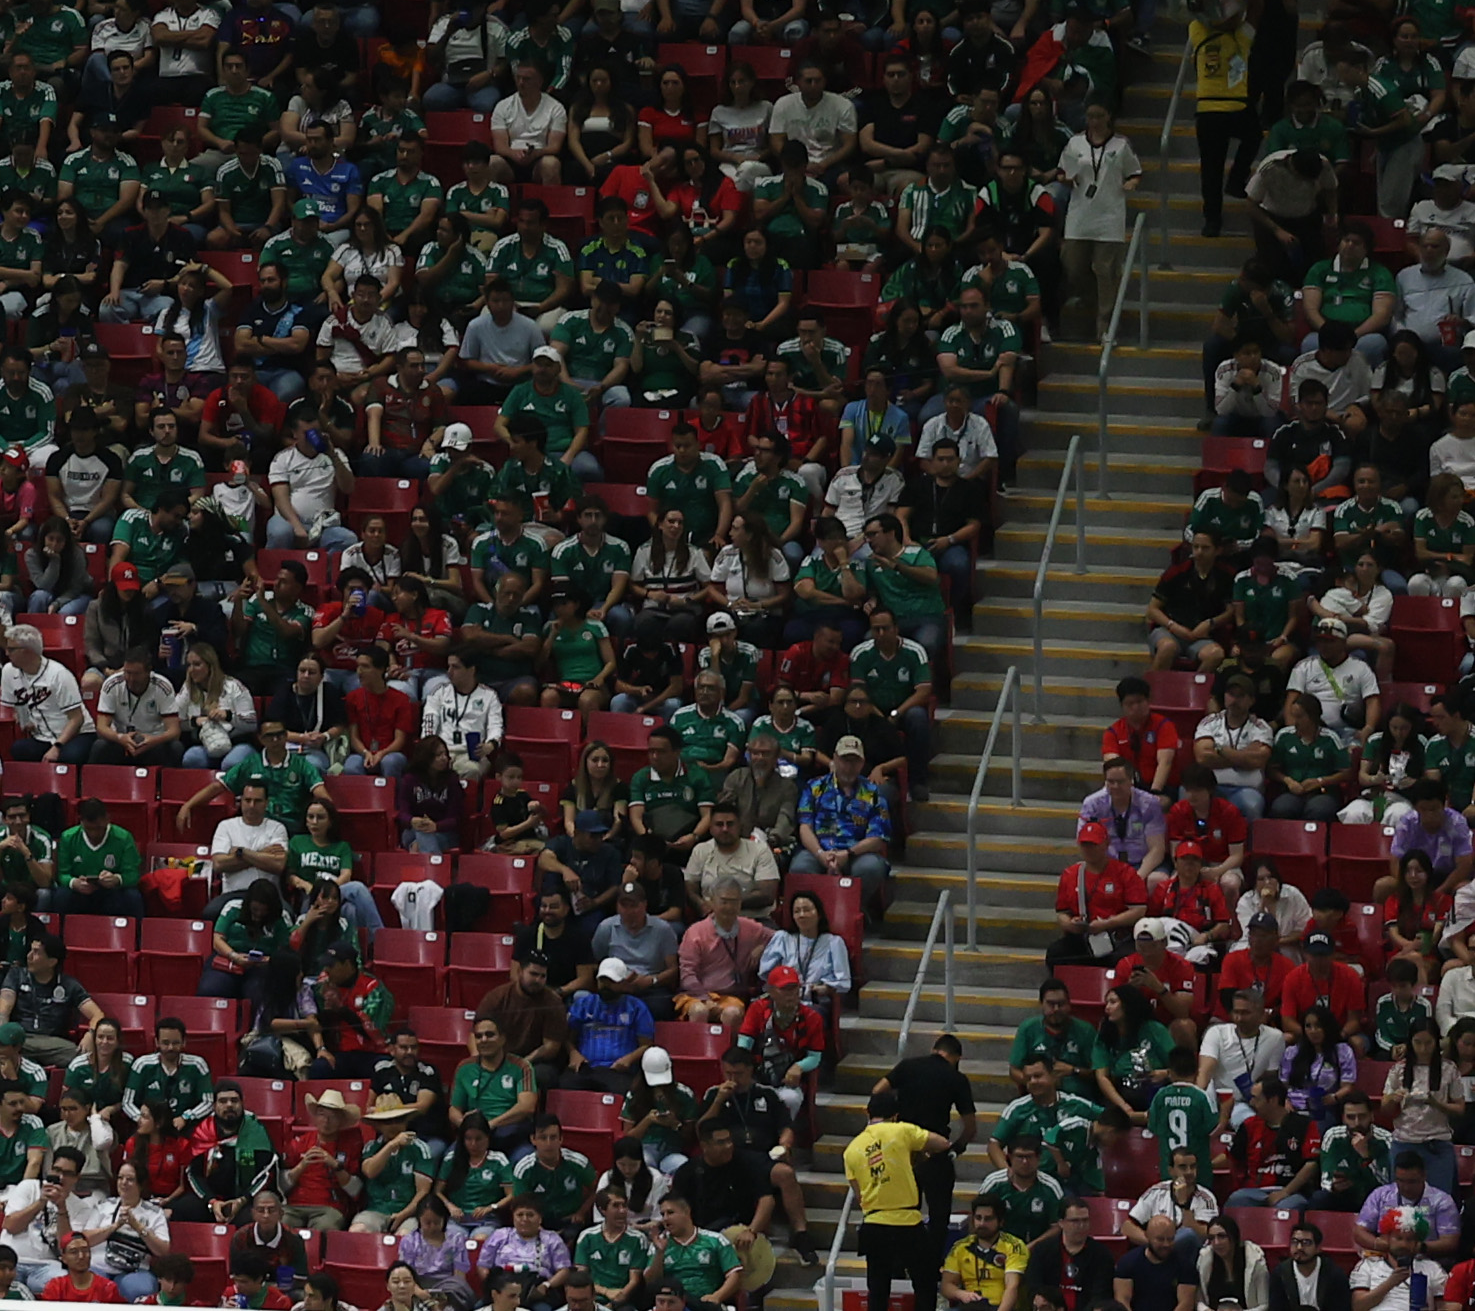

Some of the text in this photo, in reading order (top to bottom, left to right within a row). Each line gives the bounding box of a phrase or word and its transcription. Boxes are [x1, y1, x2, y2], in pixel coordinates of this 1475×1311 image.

[1167, 1108, 1188, 1151] 9
[864, 1138, 883, 1157] SIN
[870, 1161, 886, 1179] NO
